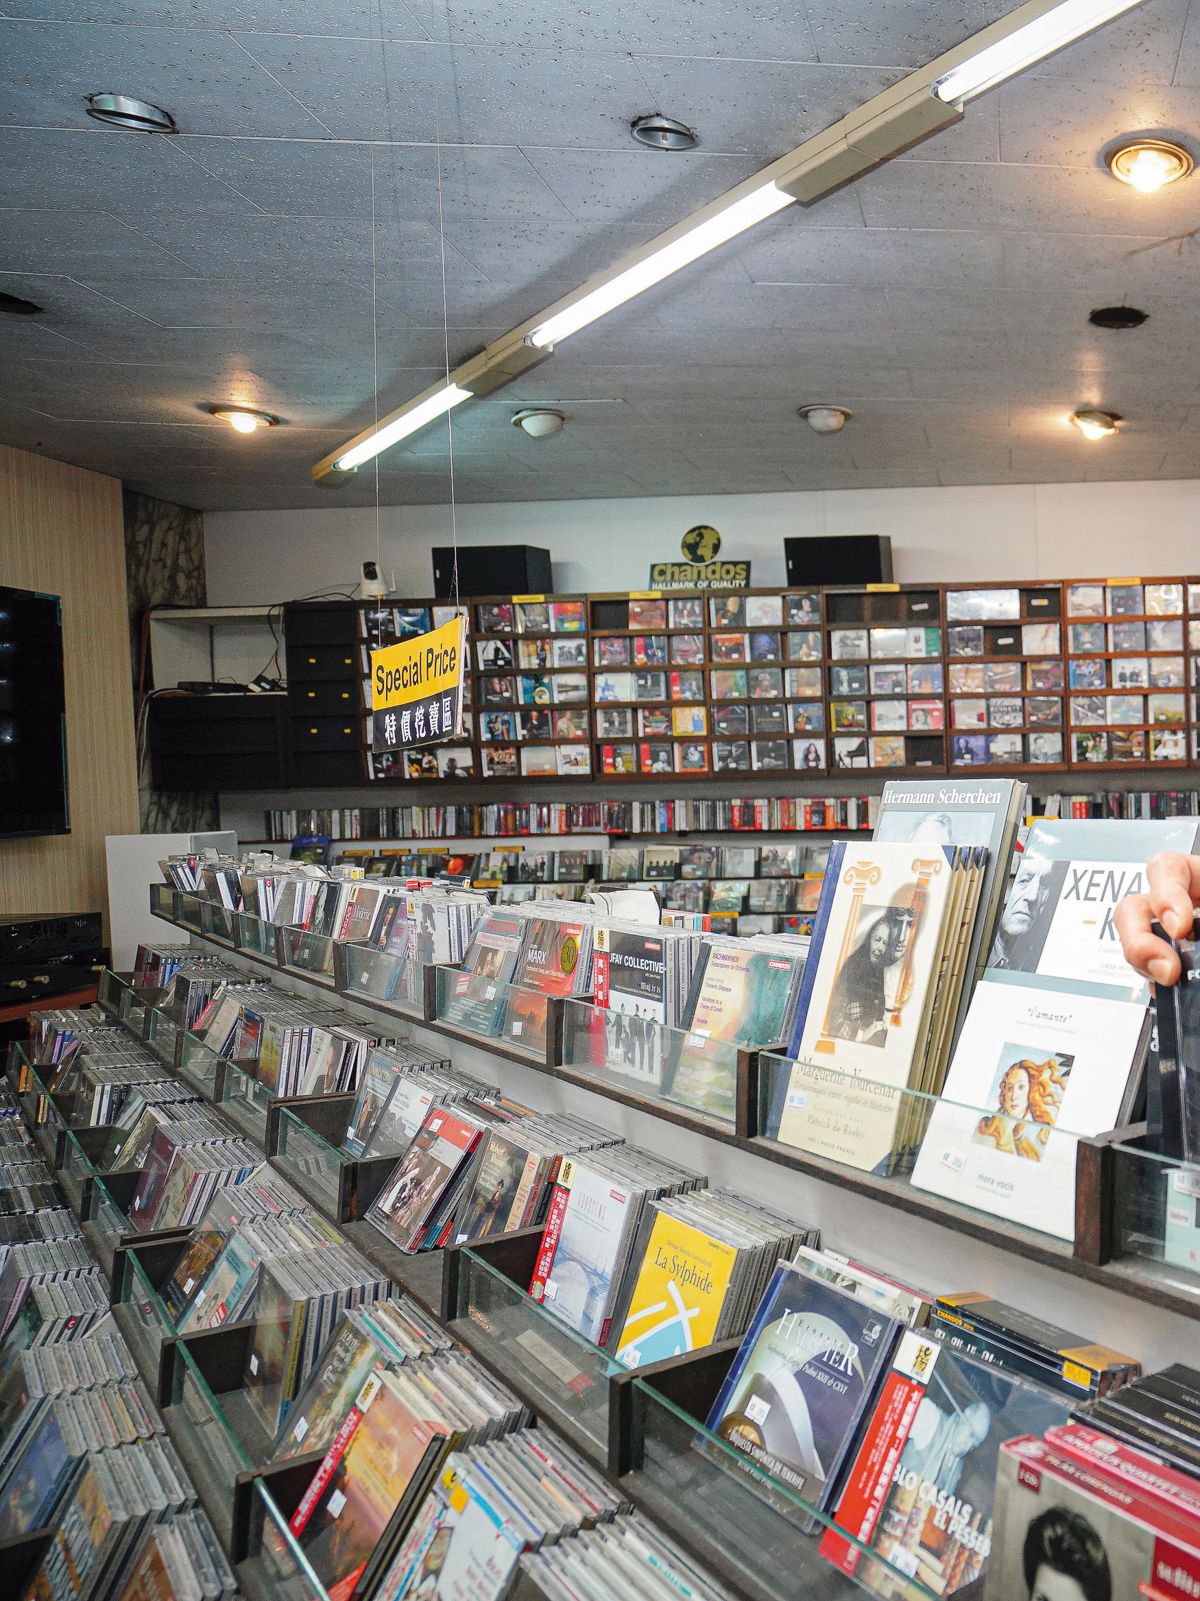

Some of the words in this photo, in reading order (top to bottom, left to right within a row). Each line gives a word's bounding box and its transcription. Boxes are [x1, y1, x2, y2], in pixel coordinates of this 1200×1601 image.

[652, 580, 695, 590] HALLMARK
[697, 580, 709, 589] OF
[710, 579, 746, 589] QUALITY
[376, 652, 422, 701] Special
[426, 643, 457, 681] Price
[384, 696, 452, 745] 特價挖寶區
[884, 790, 935, 804] Hermann
[937, 788, 1001, 804] Scherchen
[528, 948, 547, 965] MARX
[624, 955, 665, 974] COLLECTIVE
[796, 1057, 846, 1086] Marguerite
[849, 1068, 895, 1099] Yourcenar
[807, 1114, 831, 1131] Patrick
[832, 1119, 842, 1132] de
[654, 1247, 668, 1269] La
[669, 1254, 713, 1295] Sylphide
[1121, 1460, 1180, 1496] QUARTET
[893, 1464, 917, 1491] BLO
[918, 1479, 973, 1524] CASALS
[934, 1511, 948, 1531] EL
